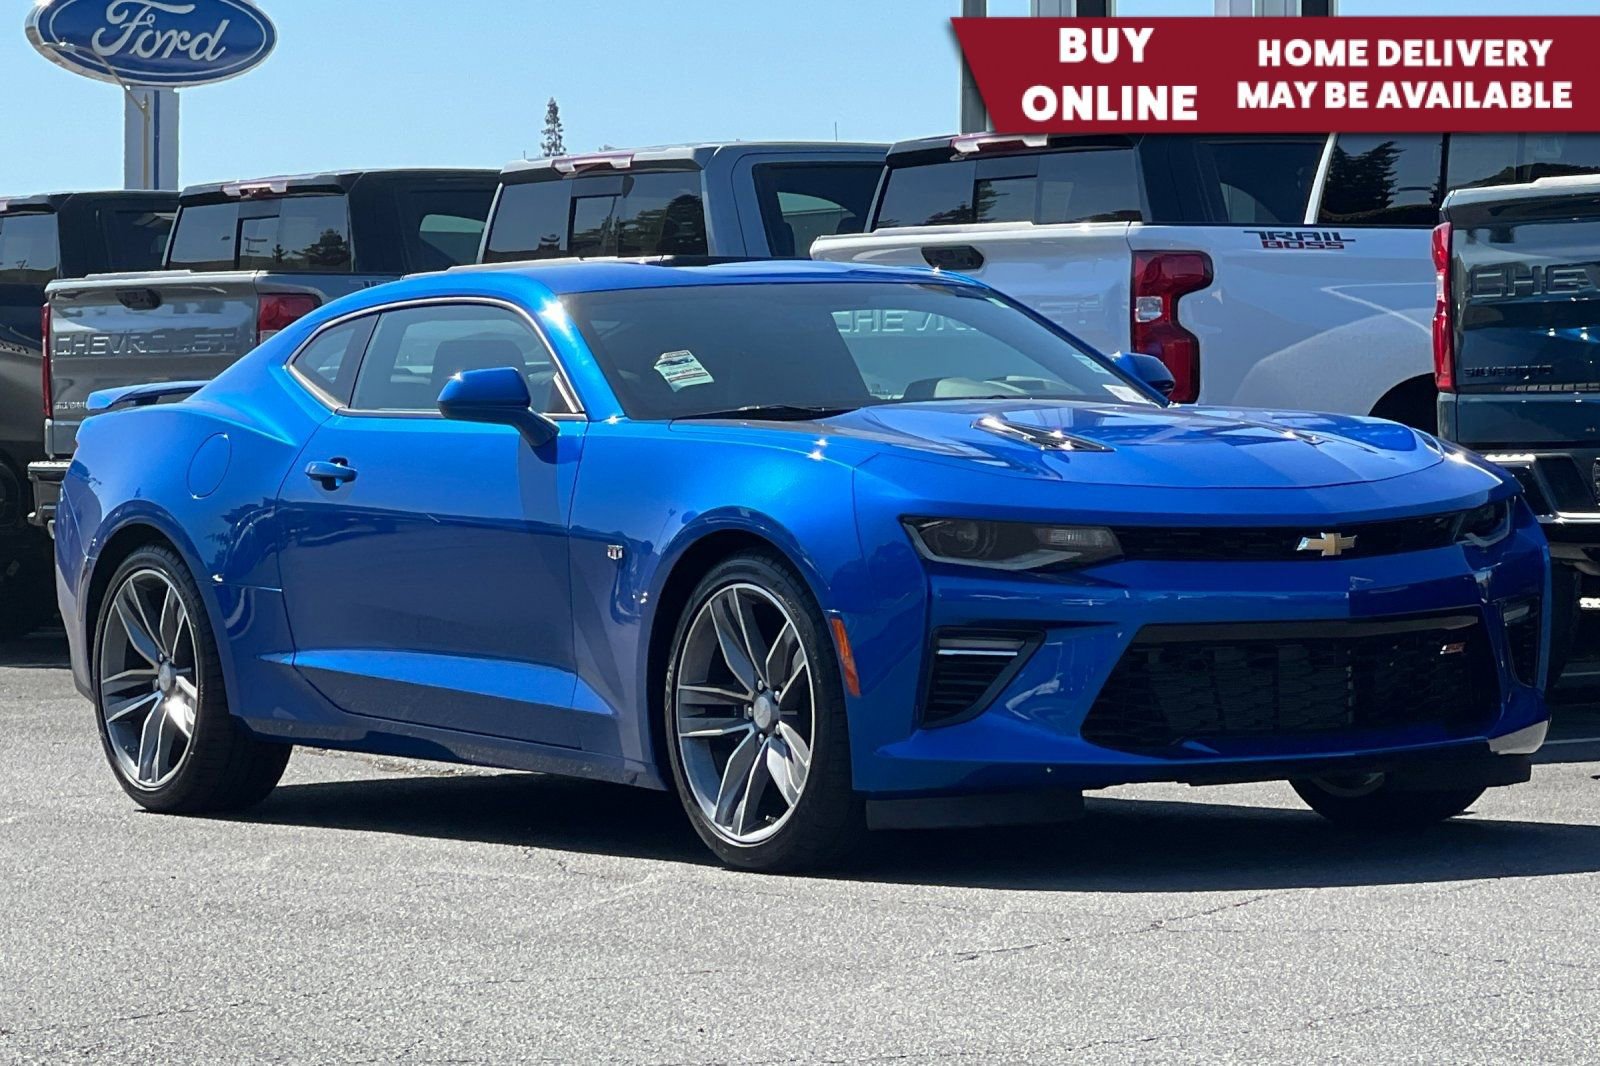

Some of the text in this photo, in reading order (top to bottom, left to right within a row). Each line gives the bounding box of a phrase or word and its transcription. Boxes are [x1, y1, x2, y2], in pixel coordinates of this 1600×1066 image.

[91, 0, 230, 62] Ford
[1243, 230, 1356, 242] TRAIL
[1261, 241, 1345, 249] BOSS
